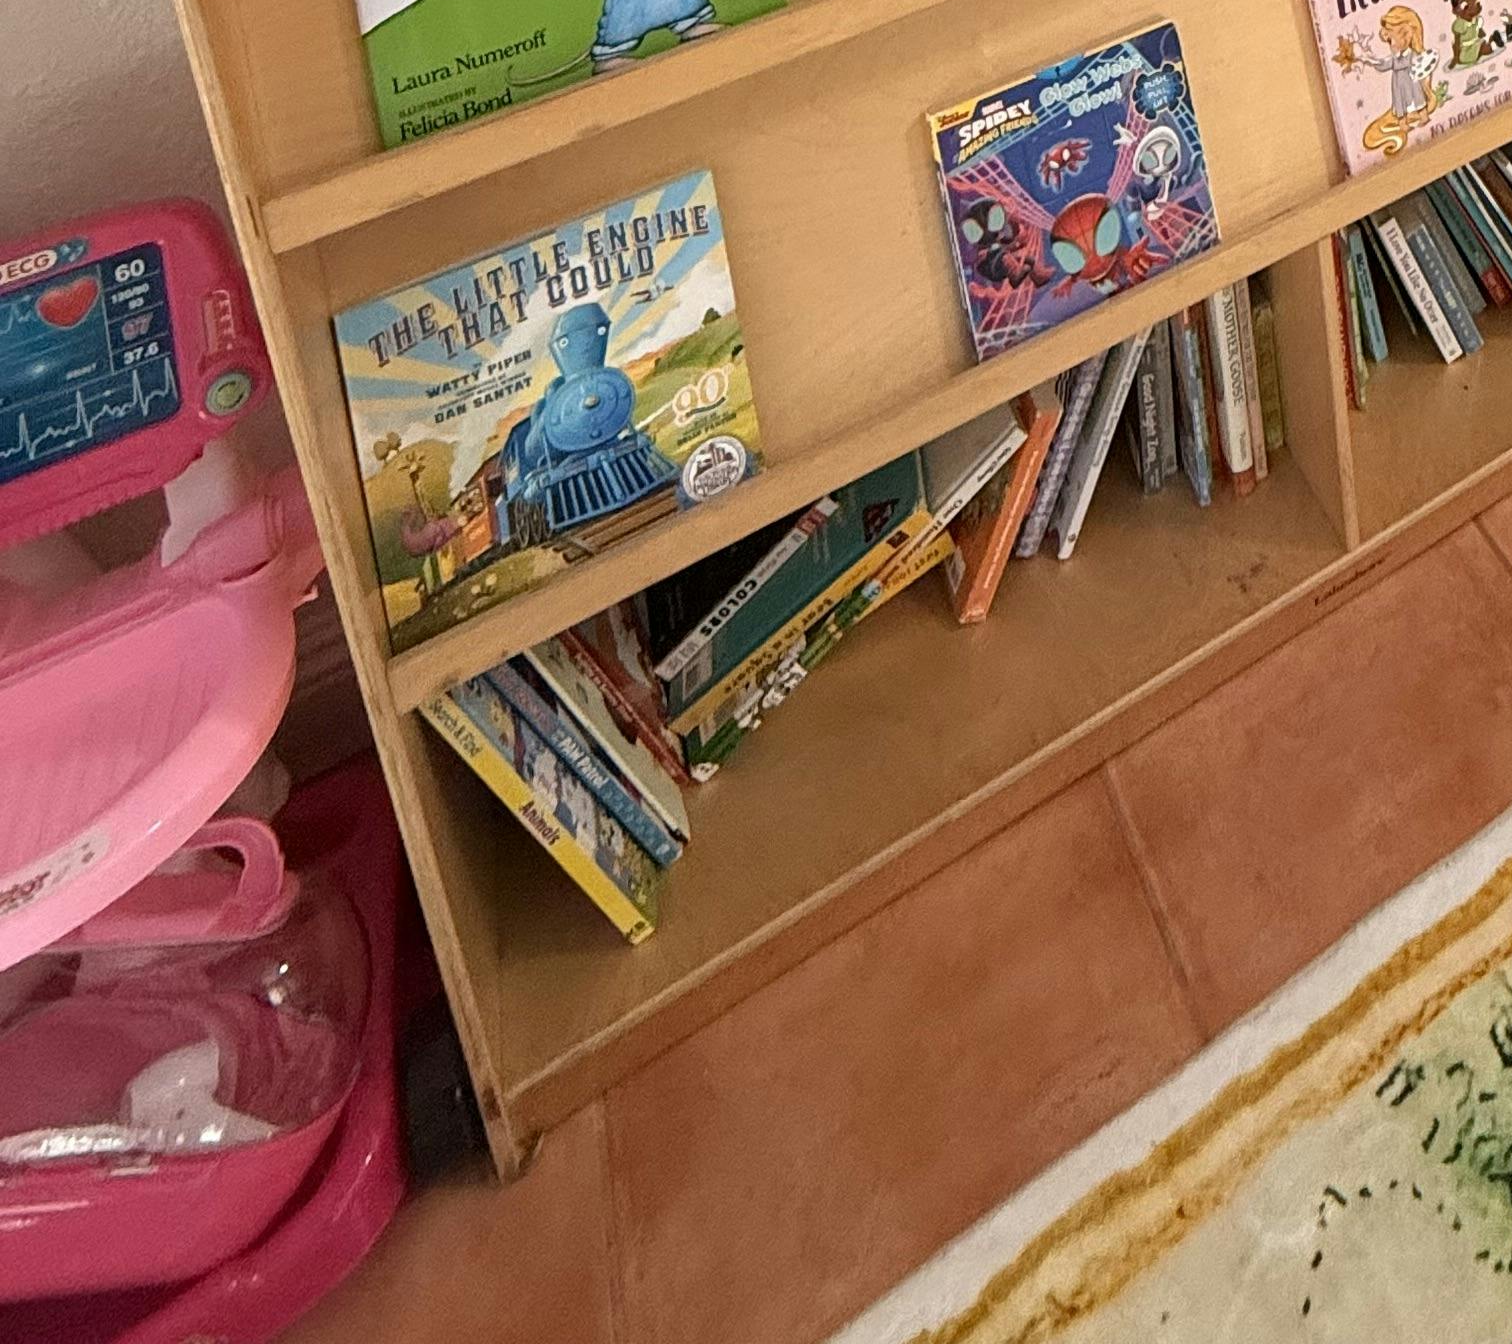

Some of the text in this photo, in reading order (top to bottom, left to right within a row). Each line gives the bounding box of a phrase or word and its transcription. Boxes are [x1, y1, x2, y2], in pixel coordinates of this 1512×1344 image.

[391, 28, 548, 95] Laura Numeroff
[1039, 53, 1142, 107] Glow Webs
[1144, 74, 1168, 89] PUSH
[400, 88, 513, 143] Felicia Bond
[1069, 81, 1122, 117] Glow!
[1148, 86, 1169, 99] PULL
[957, 98, 1033, 148] SPIDEY
[958, 127, 1001, 163] AMAZING
[7, 252, 52, 278] ECG
[114, 258, 146, 283] 60
[368, 204, 711, 368] THE LITTLE ENGINE
[1389, 234, 1406, 255] Love
[1399, 255, 1414, 273] You
[1407, 271, 1423, 290] Like
[438, 243, 657, 360] THAT COULD
[1217, 297, 1242, 361] MOTHER
[425, 368, 481, 400] WATTY
[486, 348, 534, 375] PIPER
[1140, 372, 1157, 402] Good
[1226, 360, 1248, 407] GOOSE
[433, 404, 468, 425] DAN
[472, 376, 534, 410] SANTAT
[1139, 402, 1159, 437] Night
[942, 498, 964, 520] One
[904, 521, 944, 563] Hundred
[700, 578, 758, 637] COLORS
[555, 733, 611, 790] PAW Patrol
[515, 796, 565, 848] Animals
